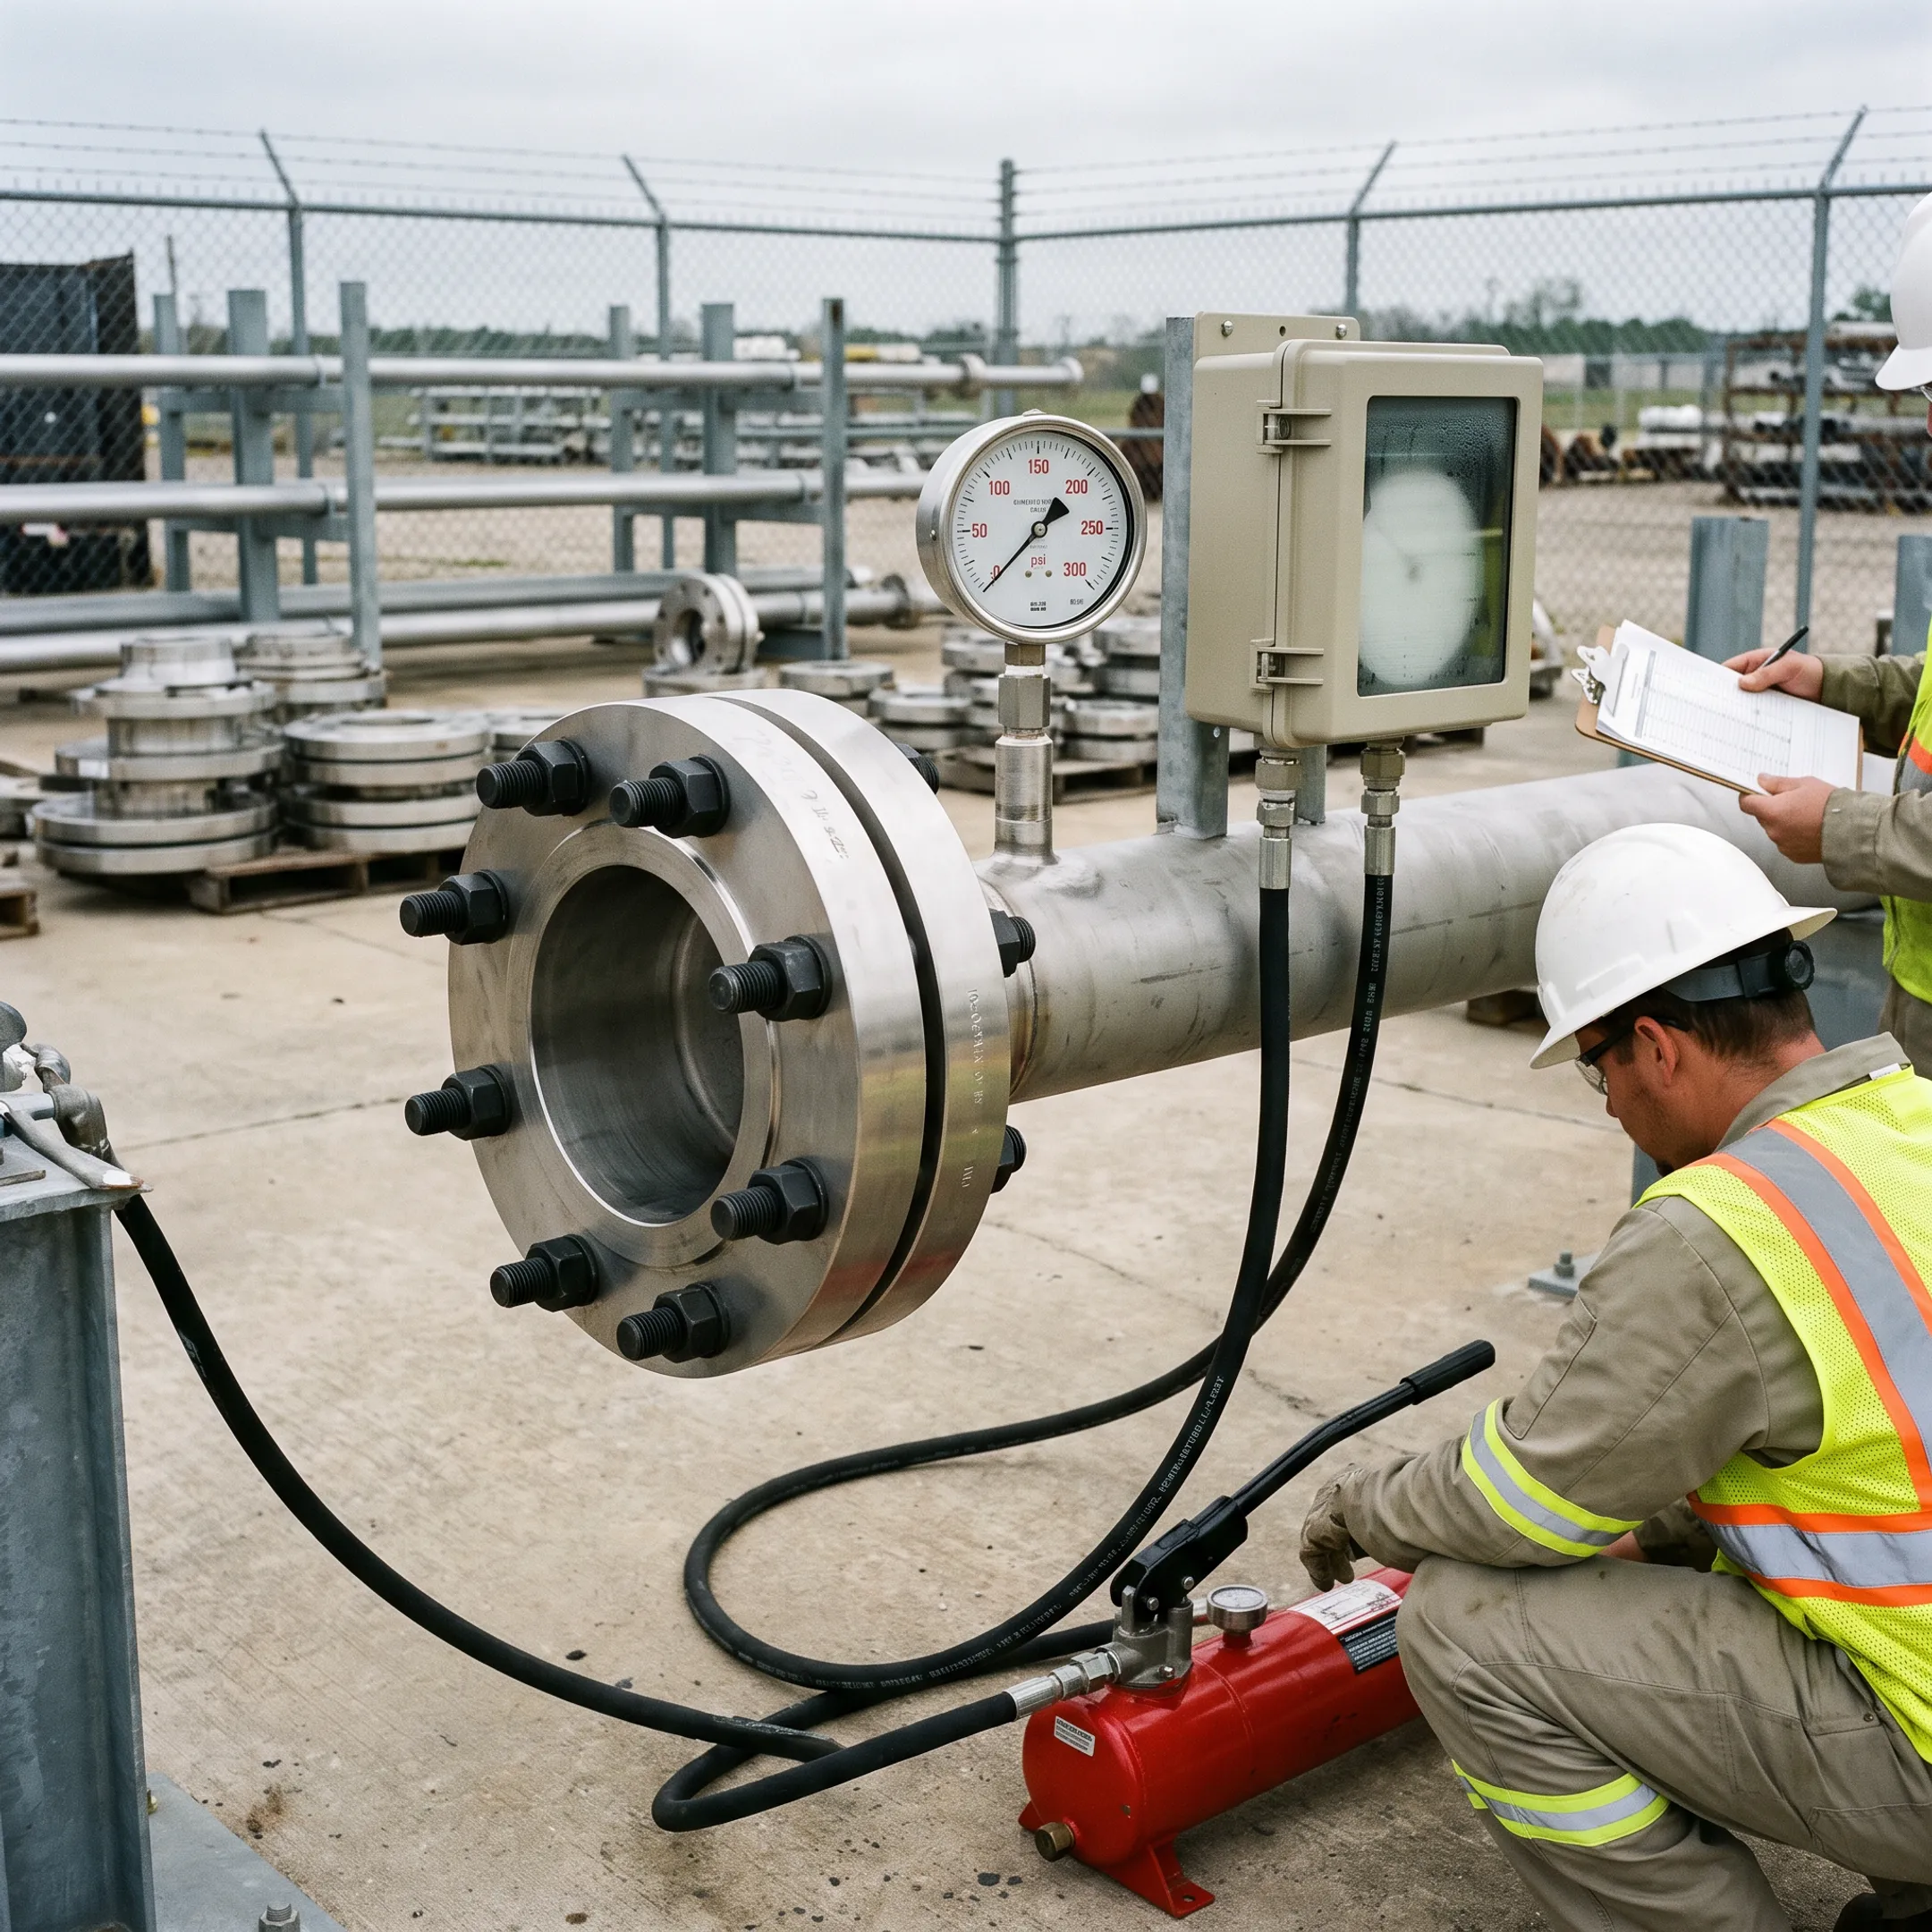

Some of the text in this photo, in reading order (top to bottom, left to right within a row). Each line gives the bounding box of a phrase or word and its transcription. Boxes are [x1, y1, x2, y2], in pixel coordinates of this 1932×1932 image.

[1029, 459, 1049, 474] 150
[988, 480, 1010, 496] 100
[1065, 479, 1088, 495] 200
[971, 523, 987, 538] 50
[1080, 521, 1103, 536] 250
[1030, 554, 1046, 568] psi
[1063, 562, 1086, 577] 300
